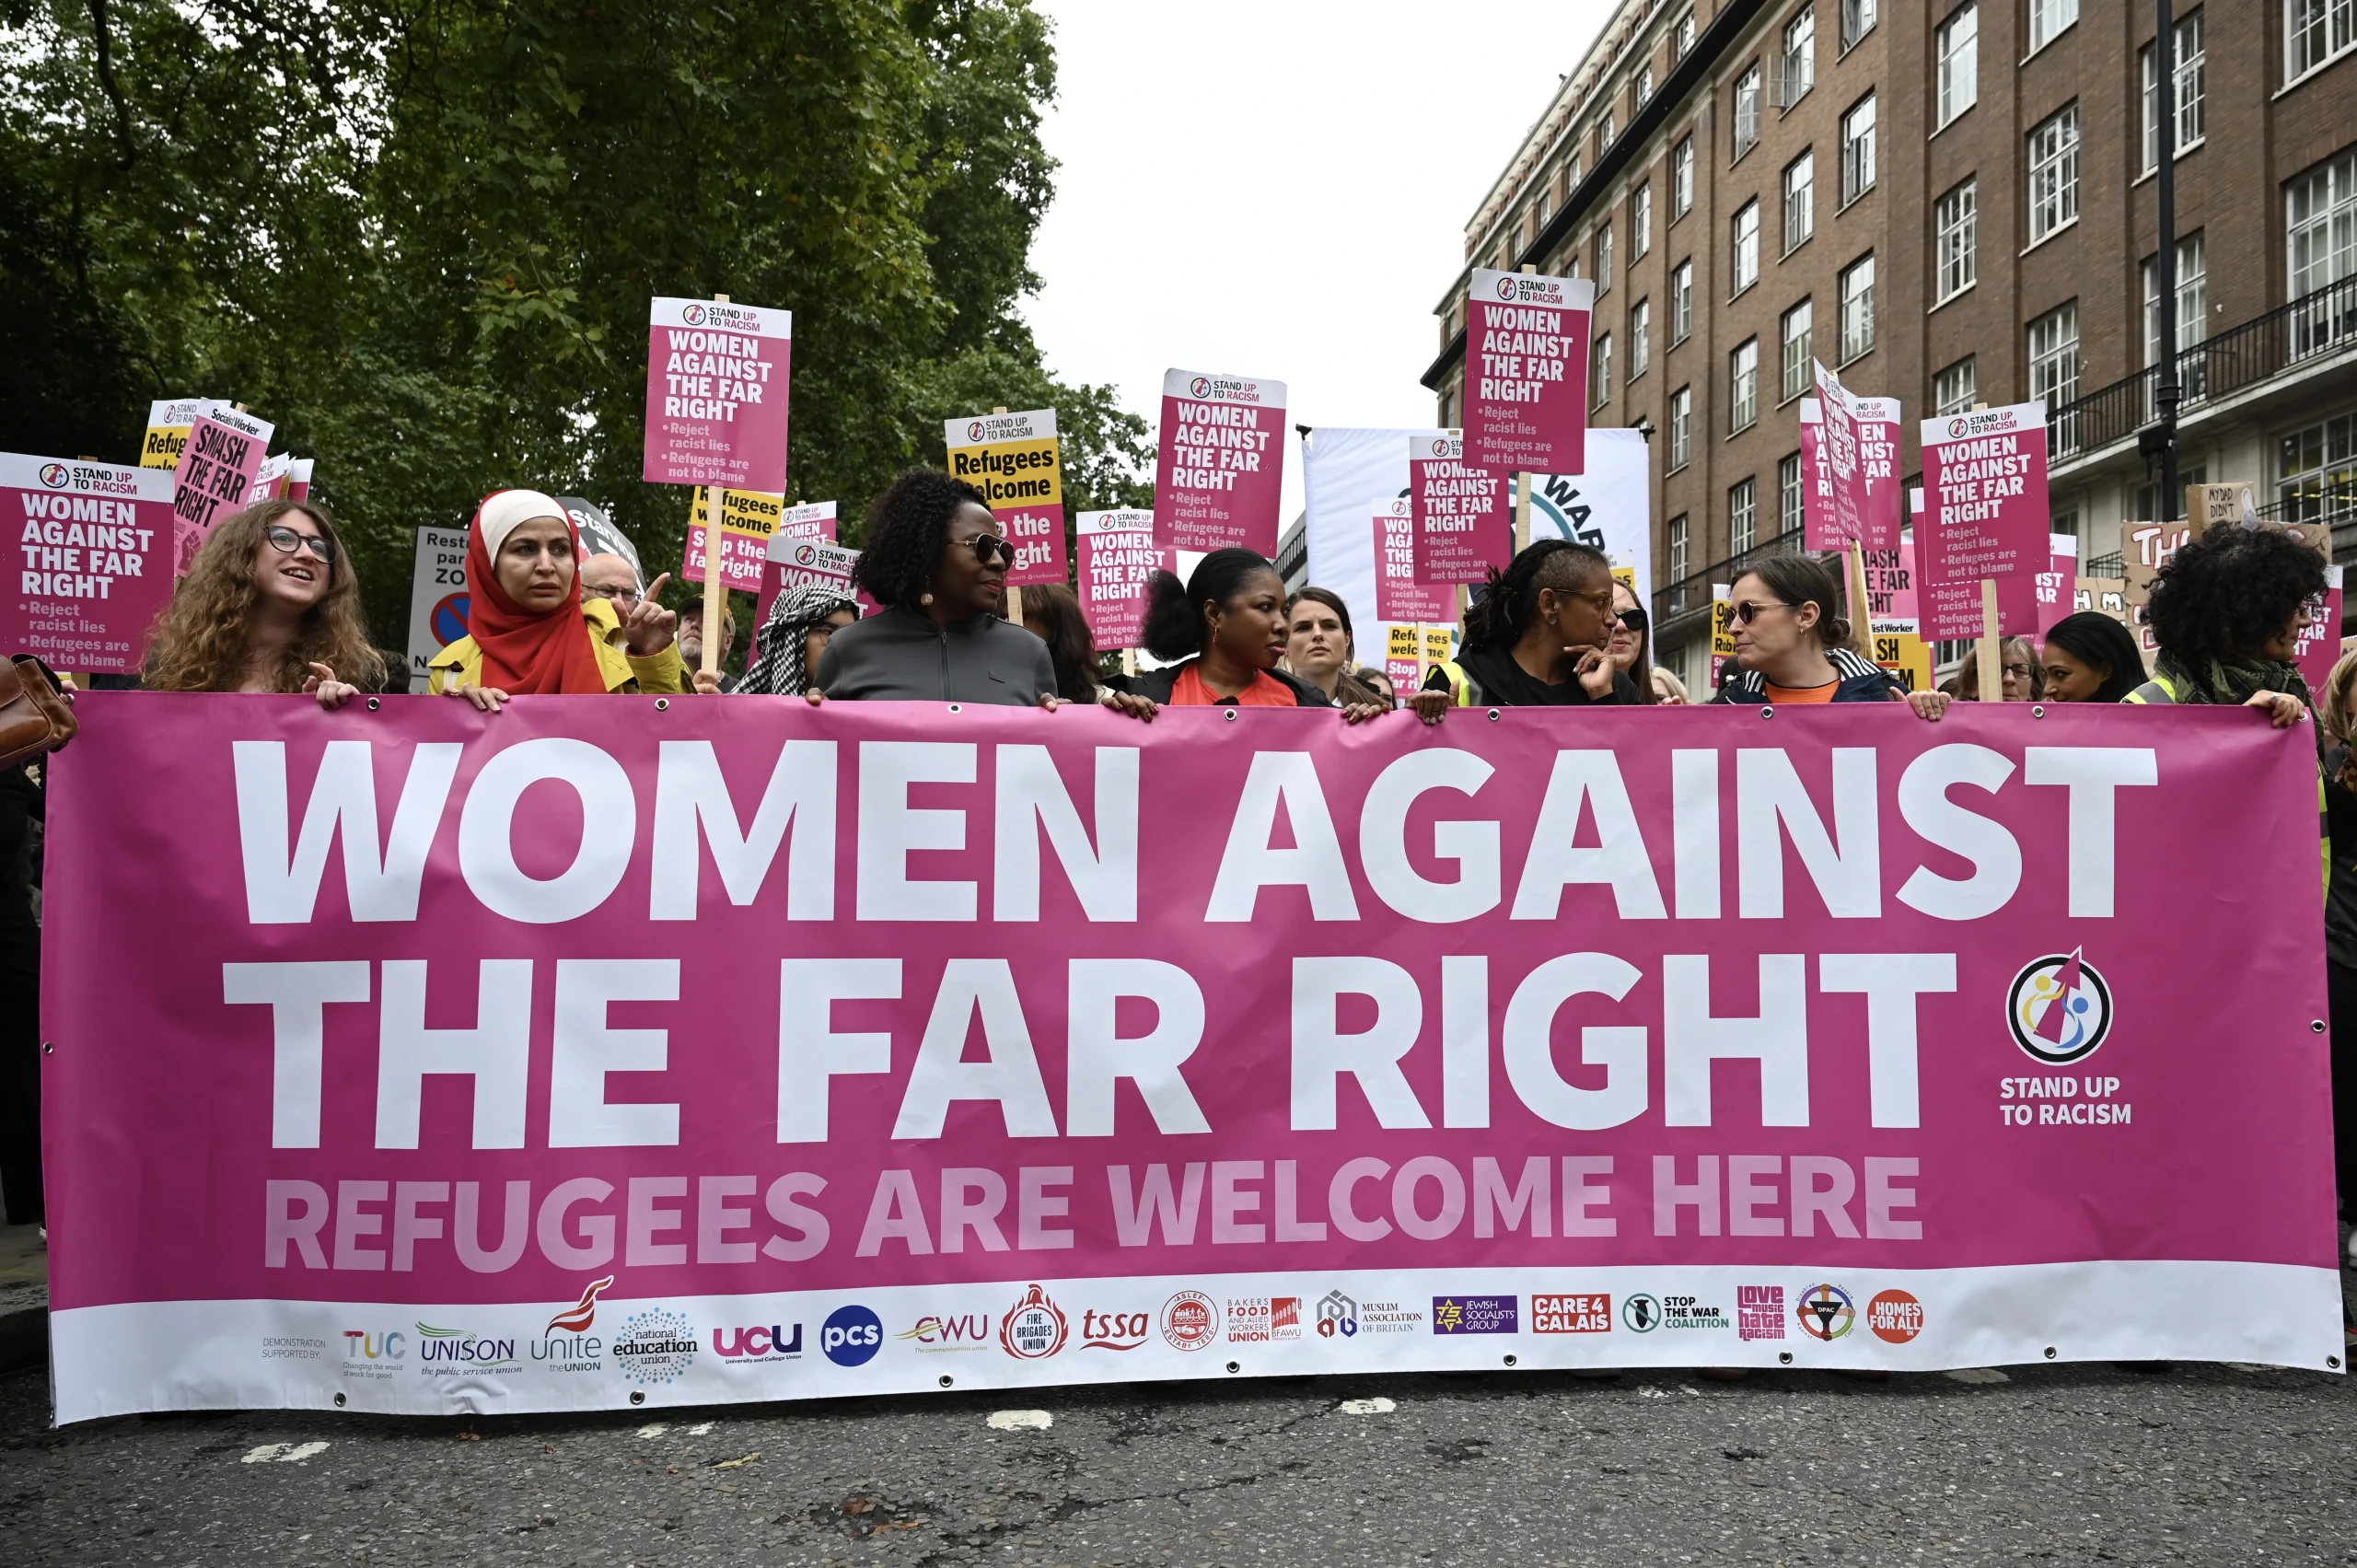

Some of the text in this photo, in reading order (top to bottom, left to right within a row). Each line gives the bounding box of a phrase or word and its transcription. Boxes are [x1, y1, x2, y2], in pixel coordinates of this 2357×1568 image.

[1519, 280, 1560, 292] STAND UP
[1519, 290, 1562, 305] TO RACISM
[1484, 306, 1561, 333] WOMEN
[668, 331, 758, 358] WOMEN
[1481, 331, 1573, 358] AGAINST
[667, 354, 772, 382] AGAINST
[1482, 354, 1563, 381] THE FAR
[666, 375, 763, 404] THE FAR
[1480, 377, 1543, 403] RIGHT
[665, 397, 737, 422] RIGHT
[1177, 402, 1257, 428] WOMEN
[234, 416, 260, 436] Worker
[986, 416, 1028, 429] STAND UP
[987, 426, 1033, 439] TO RACISM
[1175, 424, 1270, 451] AGAINST
[195, 424, 250, 470] SMASH
[1938, 436, 2016, 465] WOMEN
[954, 449, 1053, 480] Refugees
[1174, 446, 1260, 471] THE FAR
[73, 467, 133, 481] STAND UP
[1939, 454, 2031, 485] AGAINST
[74, 479, 137, 494] TO RACISM
[185, 454, 213, 490] THE
[208, 466, 246, 505] FAR
[980, 475, 1051, 500] elcome
[1171, 467, 1237, 491] RIGHT
[1423, 480, 1498, 497] AGAINST
[1939, 478, 2024, 505] THE FAR
[21, 494, 135, 526] WOMEN
[175, 484, 219, 528] RIGHT
[1424, 497, 1492, 514] THE FAR
[1940, 498, 2003, 525] RIGHT
[2211, 504, 2234, 518] DIDN'T
[1013, 514, 1051, 537] the
[1425, 516, 1476, 532] RIGHT
[21, 521, 154, 552] AGAINST
[567, 509, 639, 570] Starving
[21, 546, 143, 576] THE FAR
[21, 571, 113, 599] RIGHT
[1880, 570, 1910, 590] FAR
[29, 601, 80, 618] Reject
[29, 619, 106, 633] racist lies
[1885, 624, 1914, 633] Worker
[29, 634, 129, 652] Refugees are
[60, 654, 75, 665] to
[80, 653, 125, 667] blame
[233, 738, 2157, 923] WOMEN AGAINST
[223, 952, 1956, 1149] THE FAR RIGHT
[2000, 1076, 2120, 1099] STAND UP
[1999, 1103, 2131, 1126] TO RACISM
[265, 1155, 1923, 1272] REFUGEES ARE WELCOME HERE
[1796, 1283, 1815, 1301] Disabled
[1228, 1298, 1269, 1307] BAKERS
[1362, 1303, 1399, 1312] MUSLIM
[1466, 1300, 1498, 1310] JEWISH
[1535, 1296, 1604, 1314] CARE 4
[1665, 1297, 1696, 1306] STOP
[1875, 1302, 1922, 1317] HOMES
[1027, 1313, 1042, 1325] FIRE
[1228, 1307, 1269, 1317] FOOD
[1363, 1313, 1422, 1322] ASSOCIATION
[1467, 1310, 1515, 1320] SOCIALISTS'
[1665, 1307, 1719, 1317] THE WAR
[915, 1315, 988, 1343] CWU
[1016, 1325, 1052, 1338] BRIGADES
[1083, 1308, 1149, 1338] tssa
[1376, 1323, 1413, 1332] BRITAIN
[1467, 1319, 1500, 1330] GROUP
[1535, 1315, 1608, 1330] CALAIS
[1665, 1318, 1729, 1328] COALITION
[1797, 1322, 1812, 1339] Against
[1870, 1316, 1922, 1330] FOR ALL
[635, 1328, 677, 1340] national
[825, 1325, 878, 1352] pcs
[1228, 1331, 1269, 1342] UNION
[1271, 1329, 1302, 1337] BFAWU
[262, 1338, 326, 1348] DEMONSTRATION
[343, 1331, 406, 1360] TUC
[421, 1340, 514, 1361] UNISON
[613, 1339, 698, 1356] education
[1023, 1338, 1046, 1351] UNION
[262, 1350, 320, 1359] SUPPORTED BY:
[641, 1354, 670, 1364] union
[343, 1362, 372, 1371] Changing
[421, 1366, 434, 1375] the
[435, 1368, 460, 1377] public
[495, 1366, 522, 1375] union
